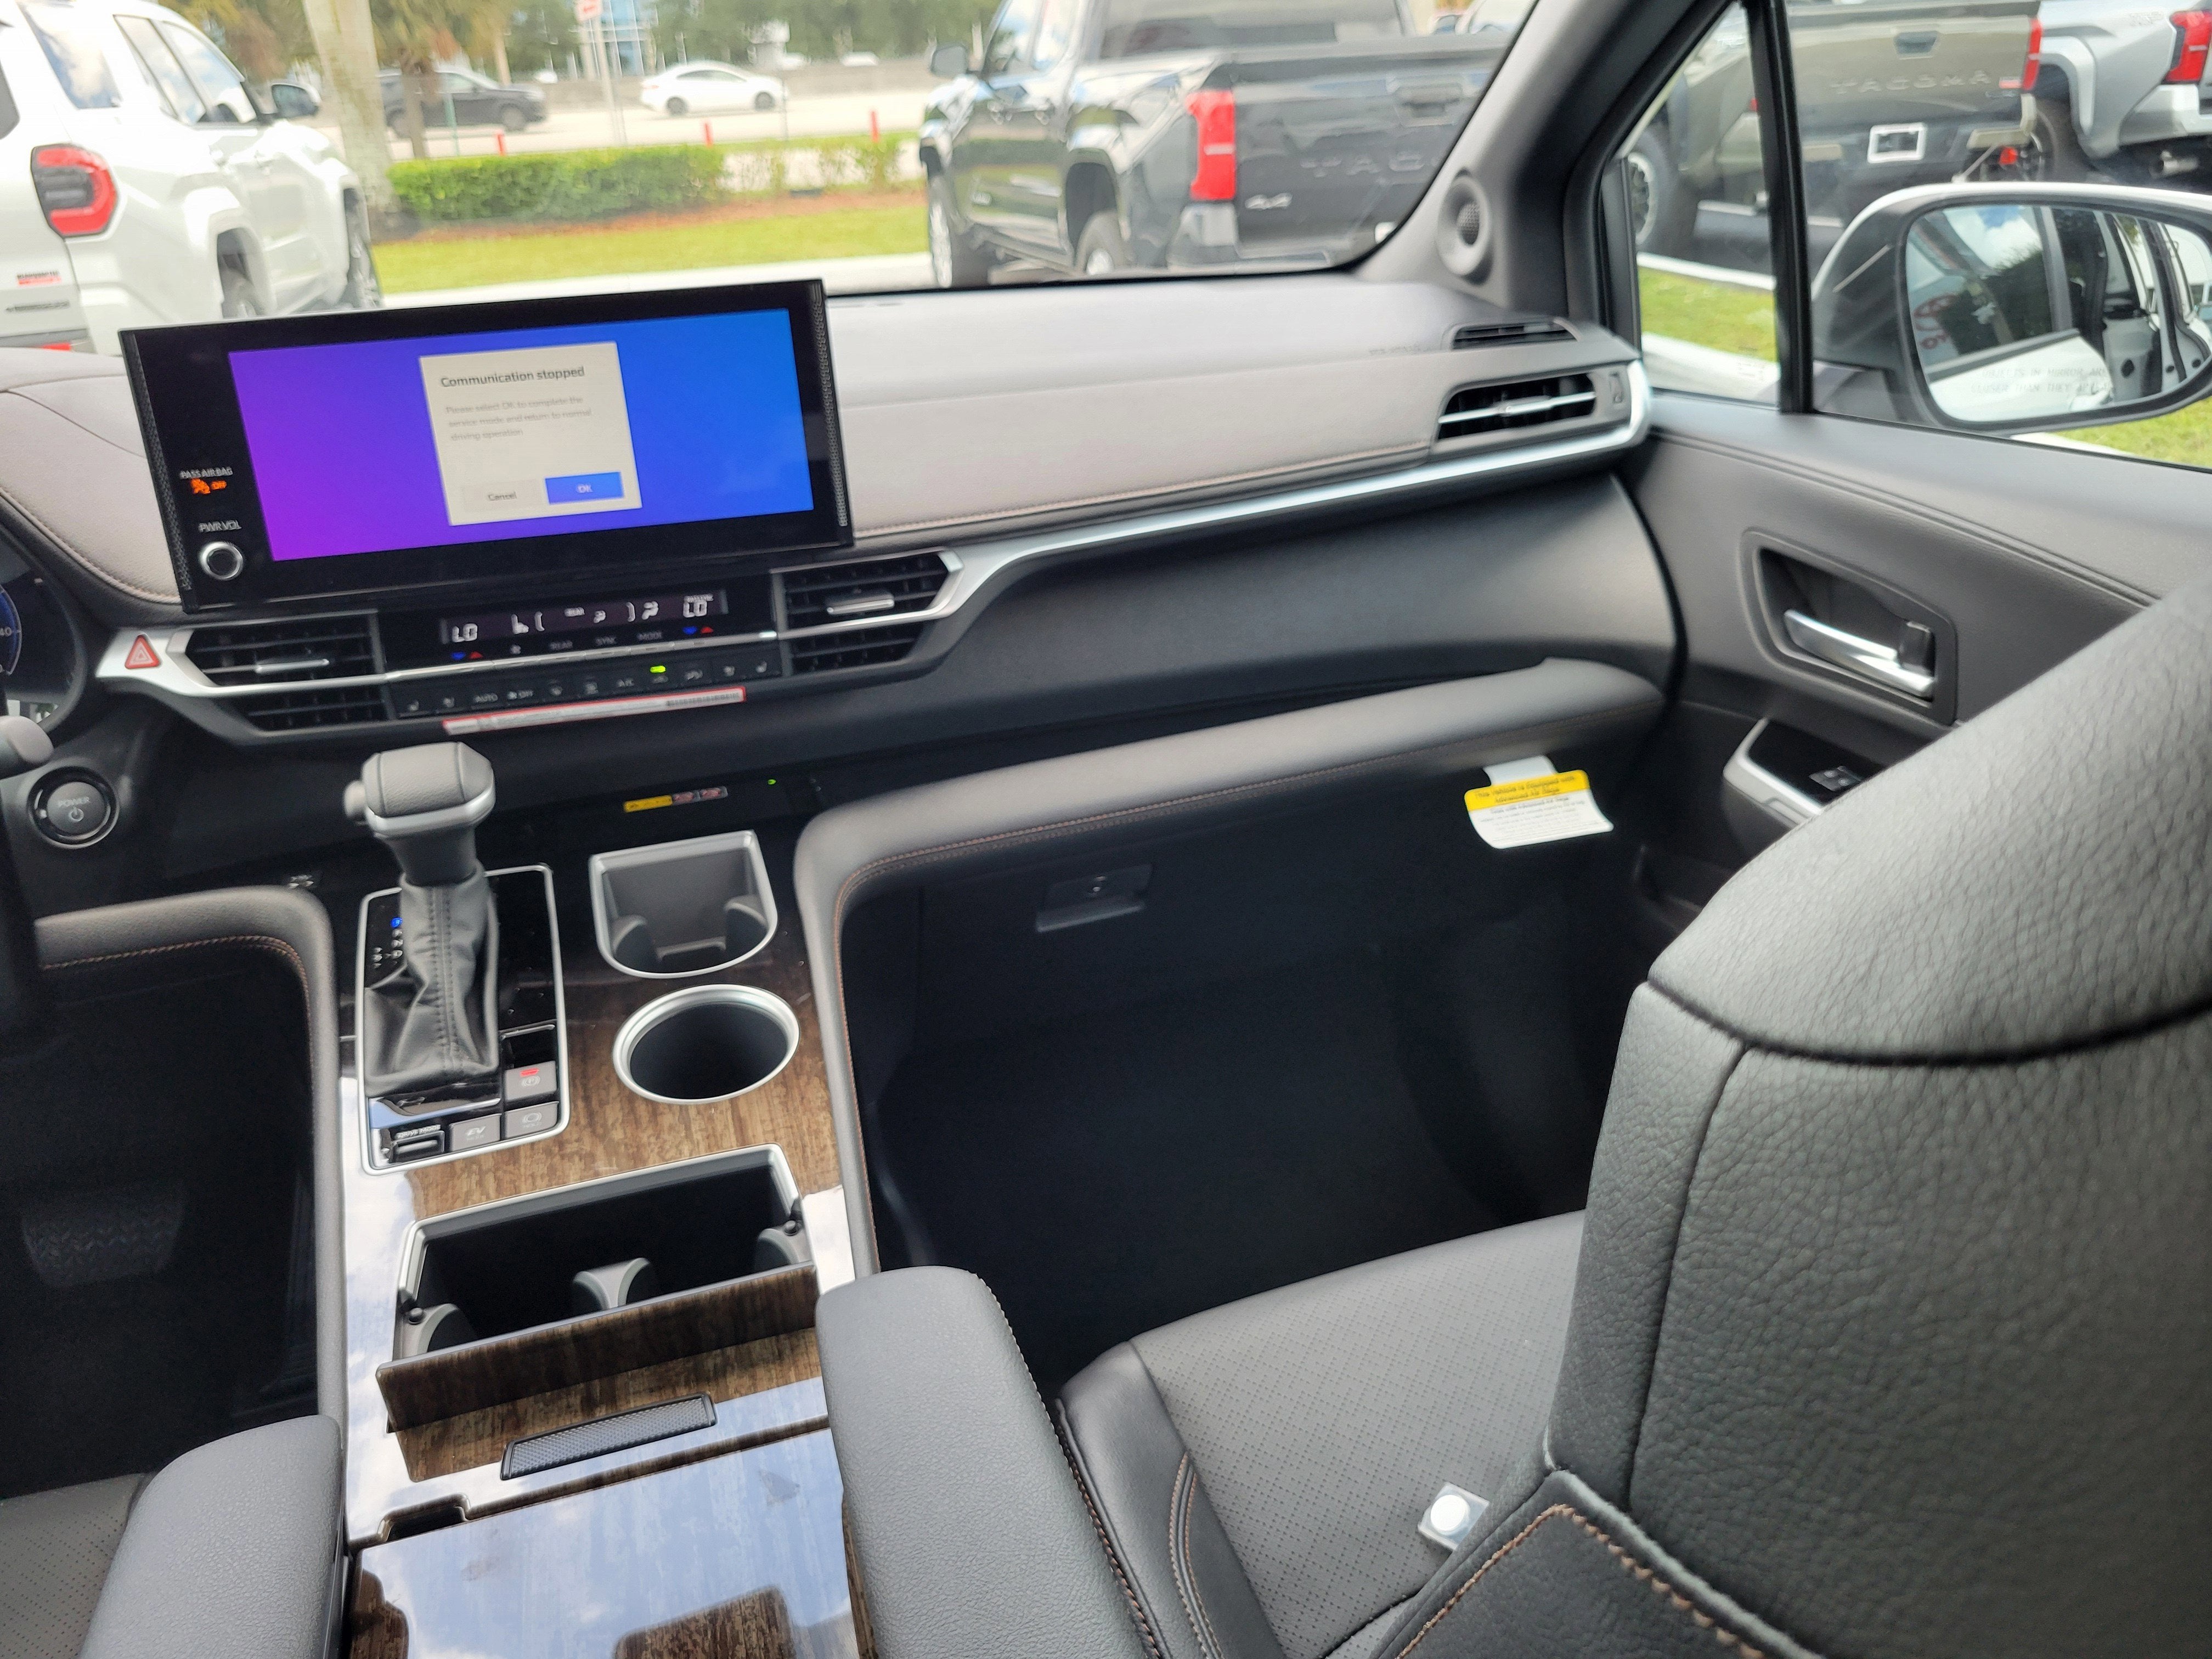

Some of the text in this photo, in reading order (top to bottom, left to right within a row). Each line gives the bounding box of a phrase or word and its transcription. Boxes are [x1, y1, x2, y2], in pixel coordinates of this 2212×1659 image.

[1829, 70, 1991, 94] TACOMA
[441, 365, 585, 387] Communication stopped
[577, 484, 592, 493] OK
[488, 491, 517, 501] Cancel
[199, 519, 241, 533] PWR VOL
[396, 1125, 441, 1139] DRIVE MODE
[467, 1125, 487, 1137] EV
